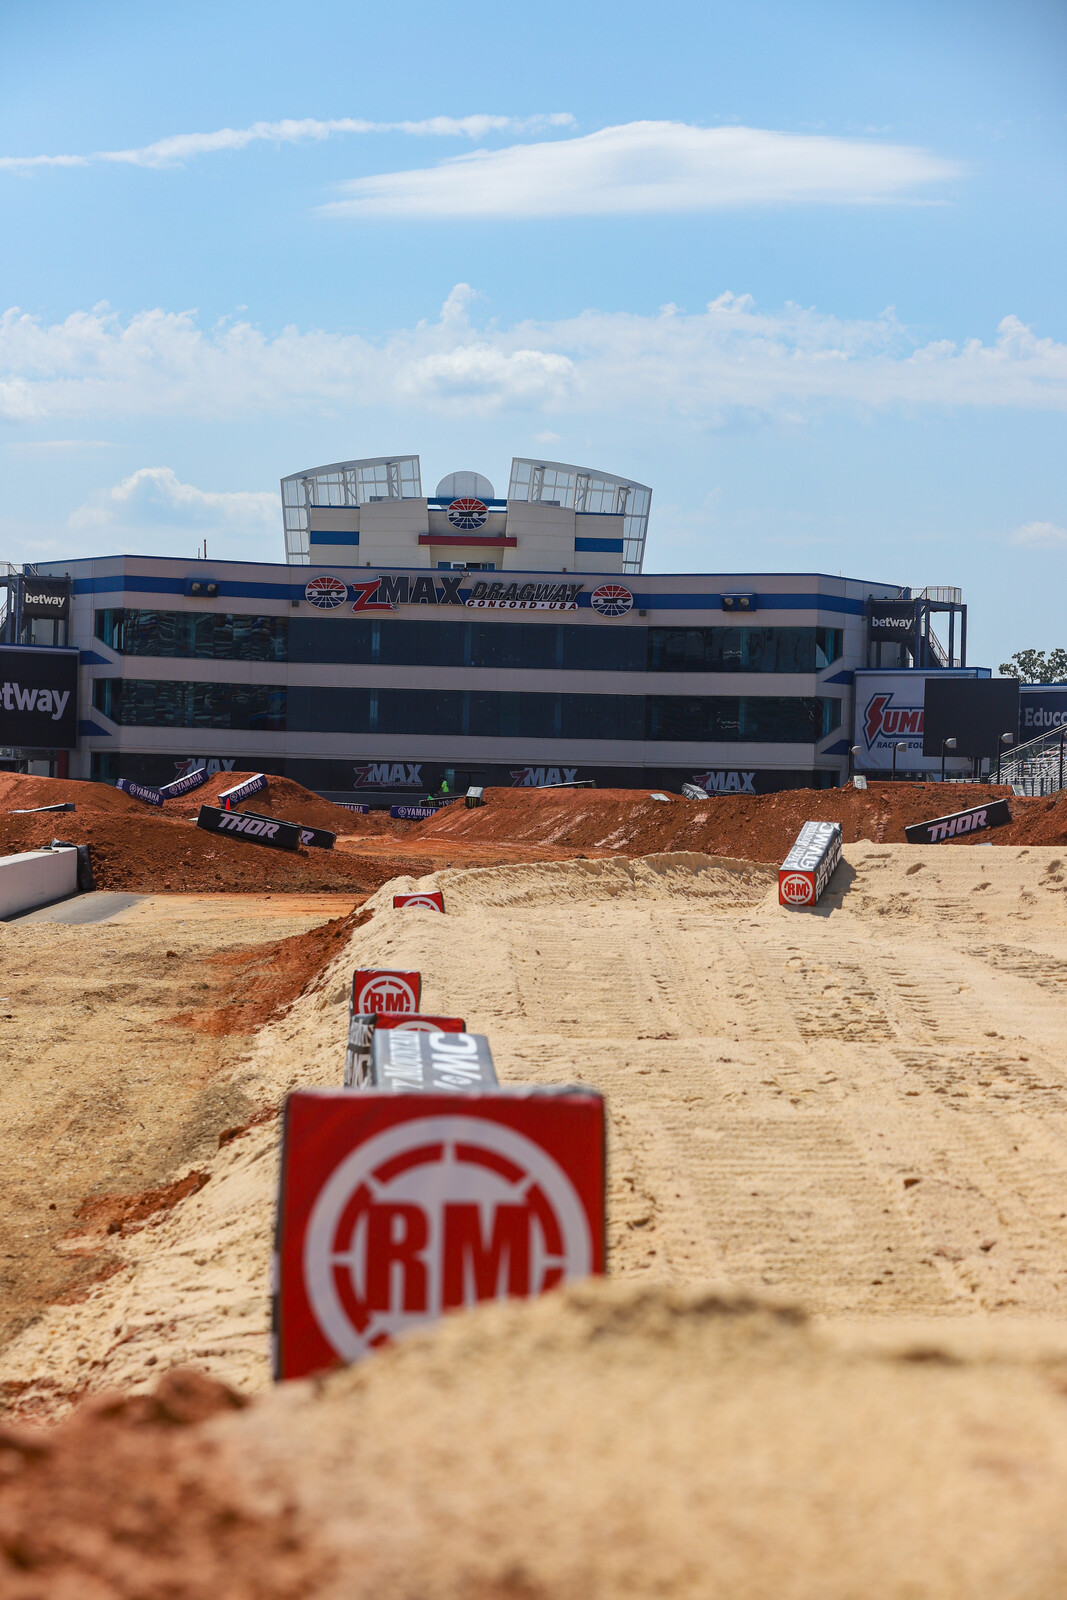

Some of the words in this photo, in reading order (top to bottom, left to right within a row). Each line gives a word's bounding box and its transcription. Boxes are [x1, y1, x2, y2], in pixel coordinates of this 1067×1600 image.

[25, 592, 65, 608] betway
[469, 582, 584, 601] DRAGWAY
[467, 599, 537, 609] CONCORD
[548, 602, 577, 610] USA
[872, 616, 912, 630] betway
[0, 682, 70, 721] tway
[176, 773, 203, 791] YAMAHA
[236, 779, 262, 797] YAMAHA
[136, 786, 160, 802] YAMAHA
[218, 813, 280, 839] THOR
[927, 810, 987, 842] THOR
[787, 883, 807, 896] RM
[370, 992, 405, 1014] RM
[363, 1202, 534, 1314] RM
